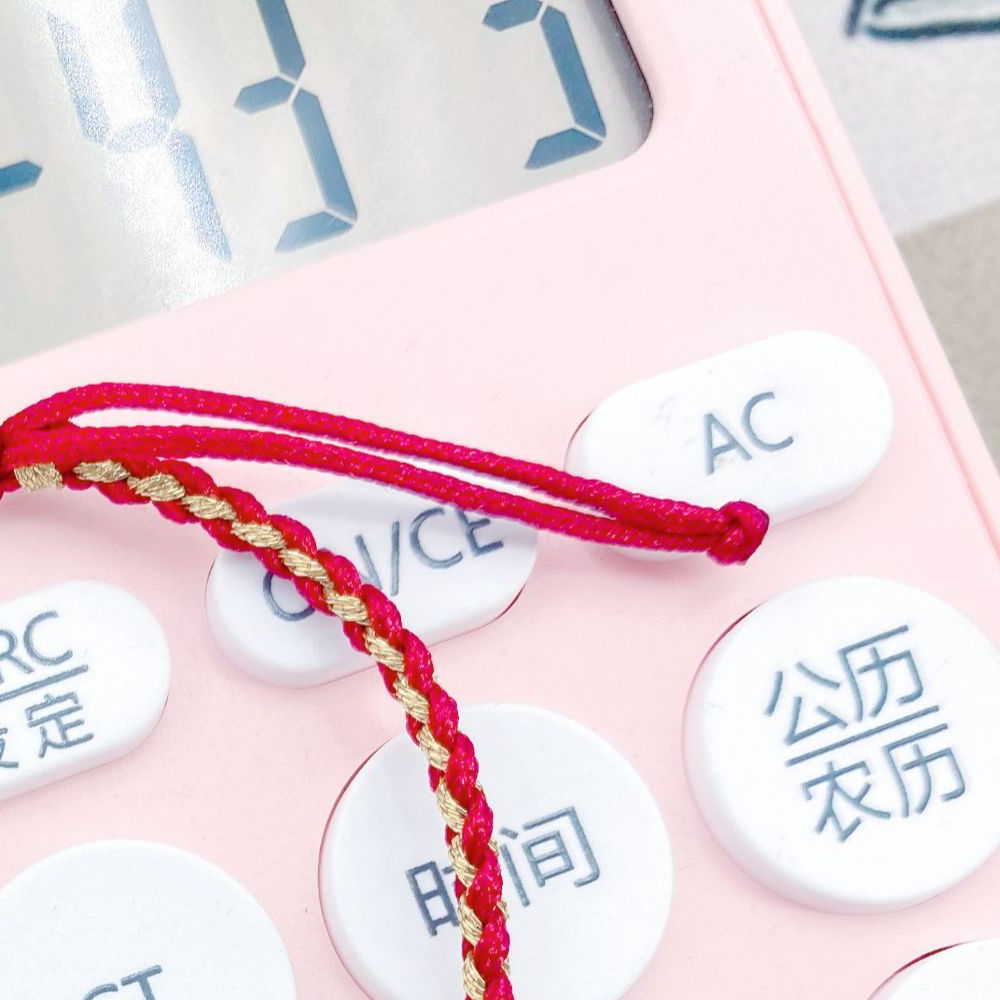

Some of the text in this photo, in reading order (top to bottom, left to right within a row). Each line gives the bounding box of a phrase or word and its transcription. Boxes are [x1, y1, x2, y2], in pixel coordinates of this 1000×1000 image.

[702, 391, 794, 476] AC
[764, 624, 925, 747] 公历
[800, 724, 966, 842] 农历
